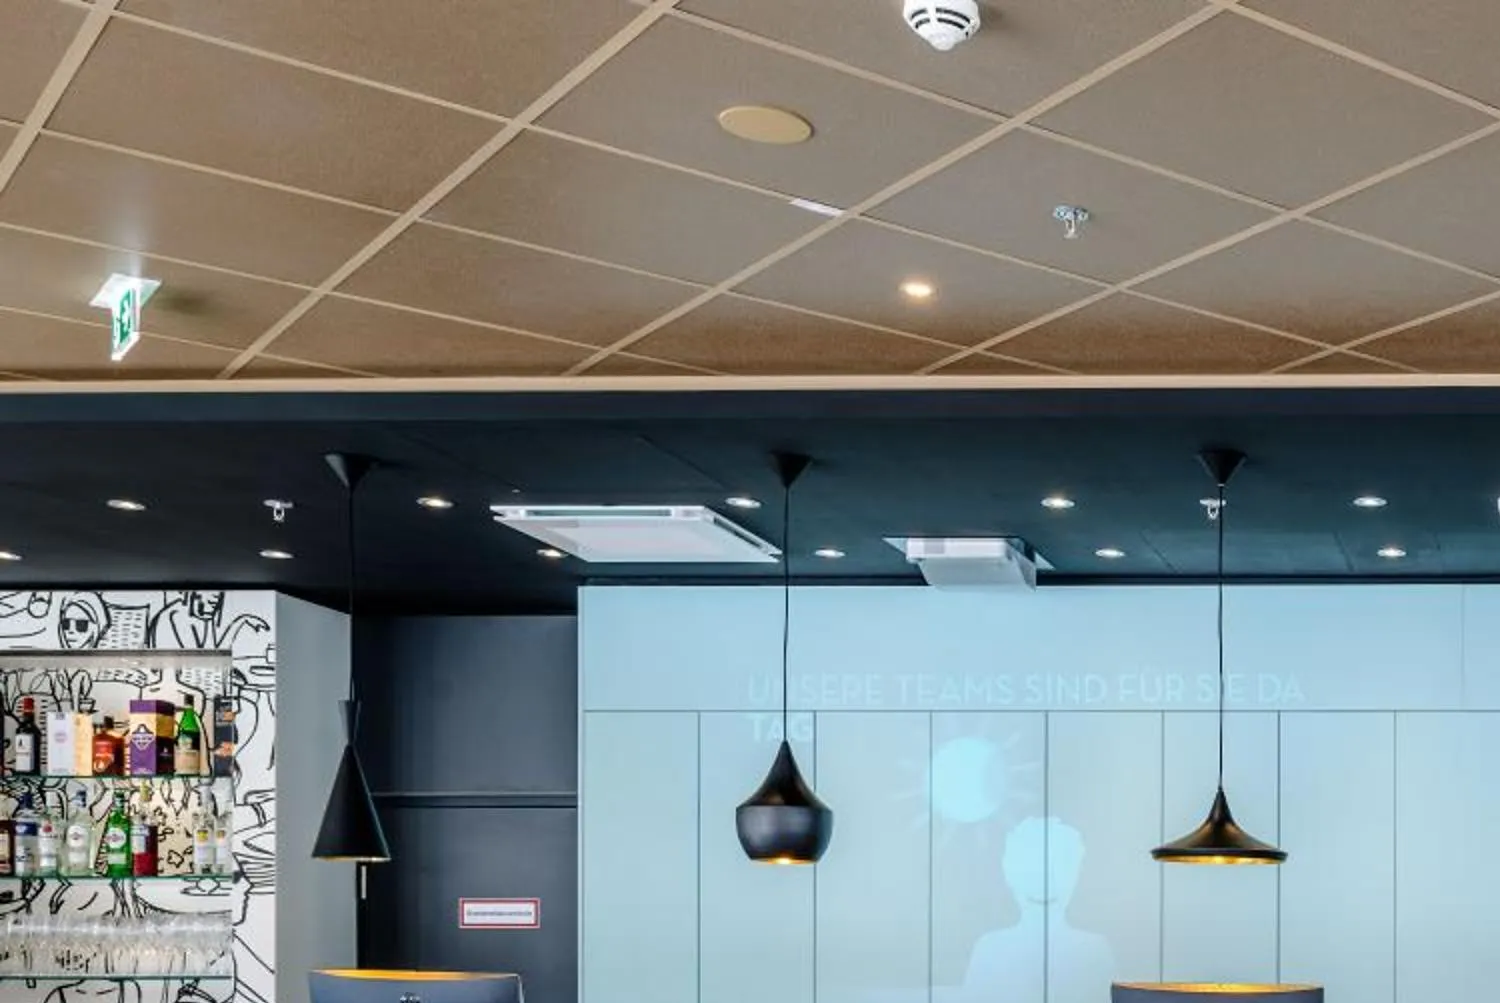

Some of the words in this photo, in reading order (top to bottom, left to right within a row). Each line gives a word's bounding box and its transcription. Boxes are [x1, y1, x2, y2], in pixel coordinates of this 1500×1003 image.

[748, 672, 884, 705] UNSERE
[893, 672, 1015, 705] TEAMS
[1023, 671, 1108, 704] SIND
[1118, 664, 1186, 704] FÜR
[1196, 671, 1248, 704] SE
[1257, 671, 1306, 704] DA
[748, 713, 813, 743] TAG
